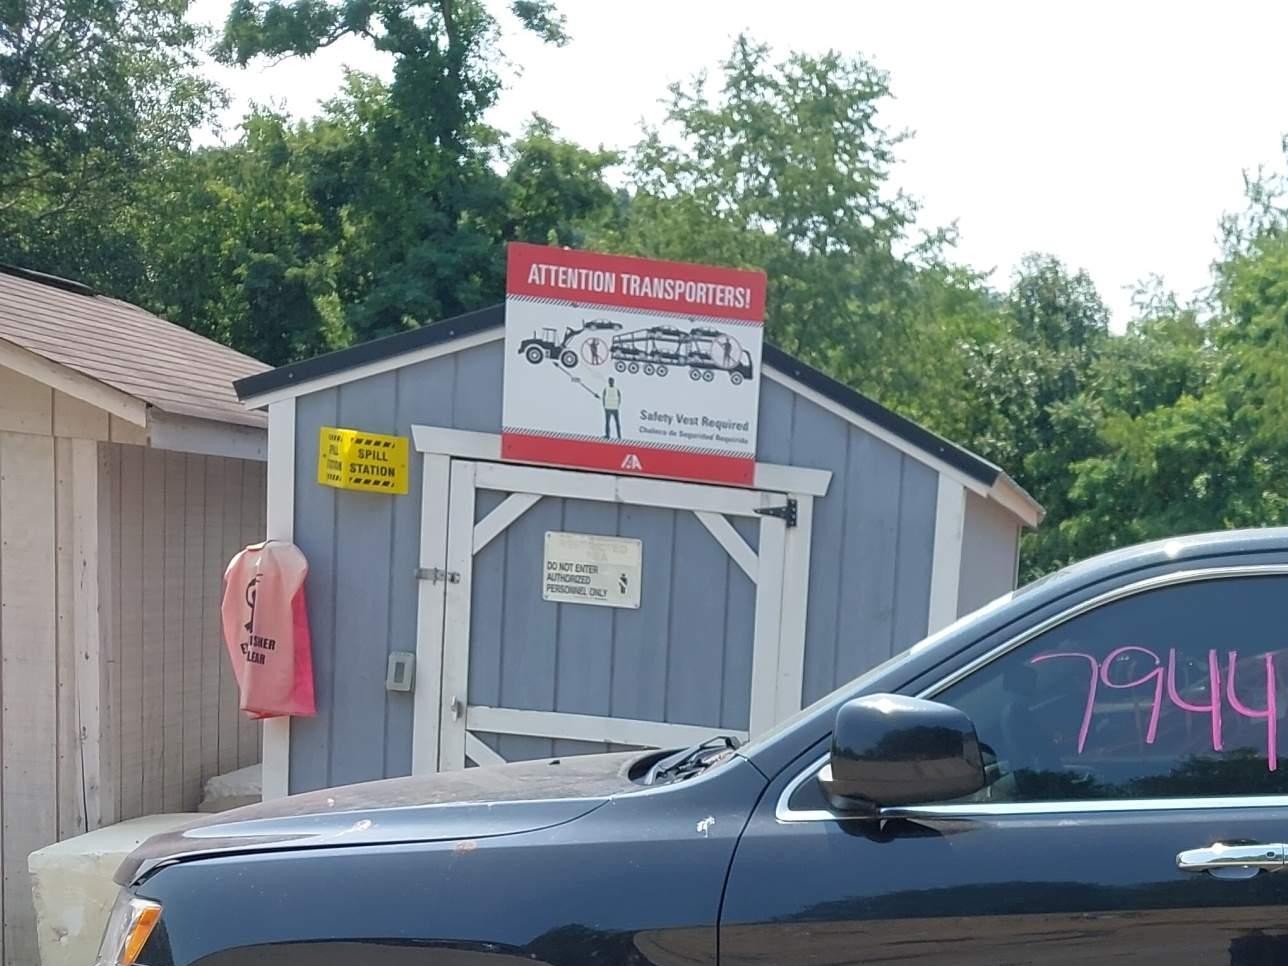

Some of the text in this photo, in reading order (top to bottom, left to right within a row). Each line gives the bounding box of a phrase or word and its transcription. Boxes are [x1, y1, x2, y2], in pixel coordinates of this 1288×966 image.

[528, 263, 751, 309] ATTENTION TRANSPORTERS!
[639, 409, 749, 431] Safety Vest Required
[358, 448, 388, 461] SPILL
[350, 463, 395, 477] STATION
[547, 561, 598, 574] DO NOT ENTER
[546, 573, 592, 585] AUTHORIZED
[589, 587, 608, 597] ONLY
[1030, 646, 1278, 772] 7944
